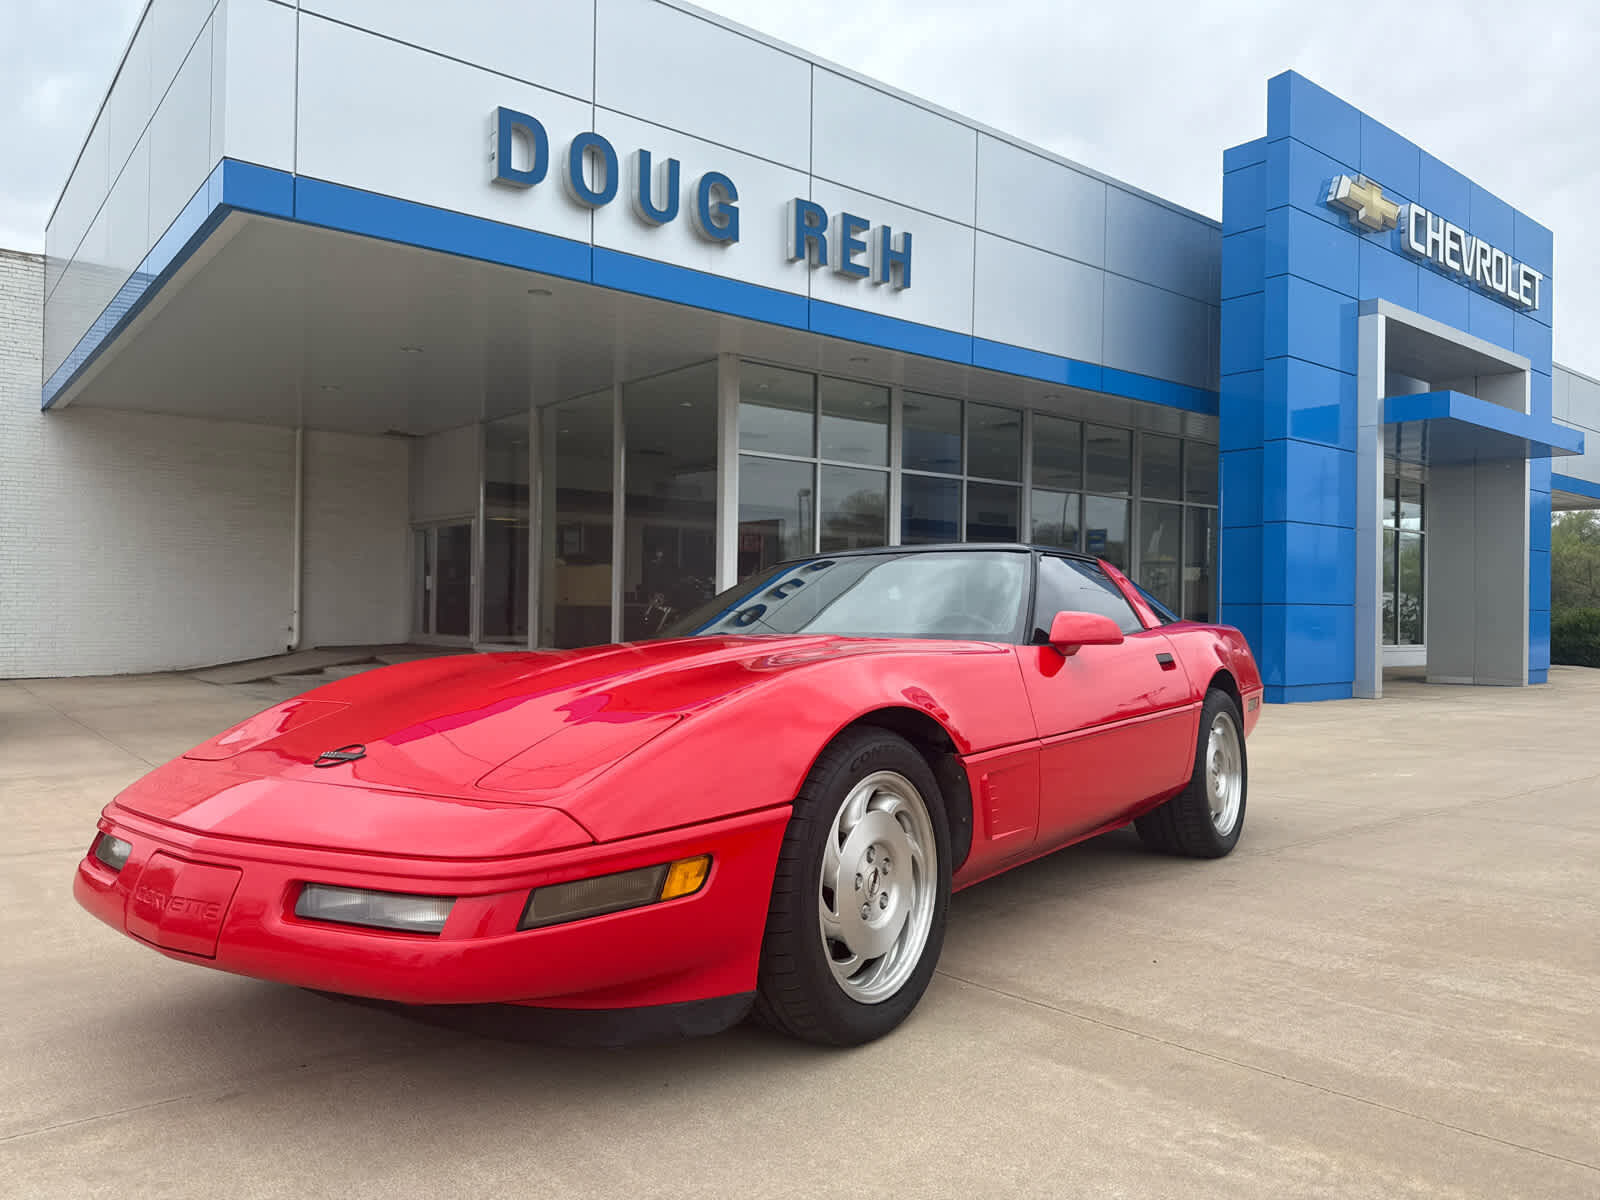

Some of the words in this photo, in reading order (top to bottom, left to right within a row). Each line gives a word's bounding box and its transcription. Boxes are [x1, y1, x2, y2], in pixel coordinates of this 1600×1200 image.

[494, 105, 740, 244] DOUG
[793, 197, 913, 290] REH
[1407, 202, 1543, 310] CHEVROLET
